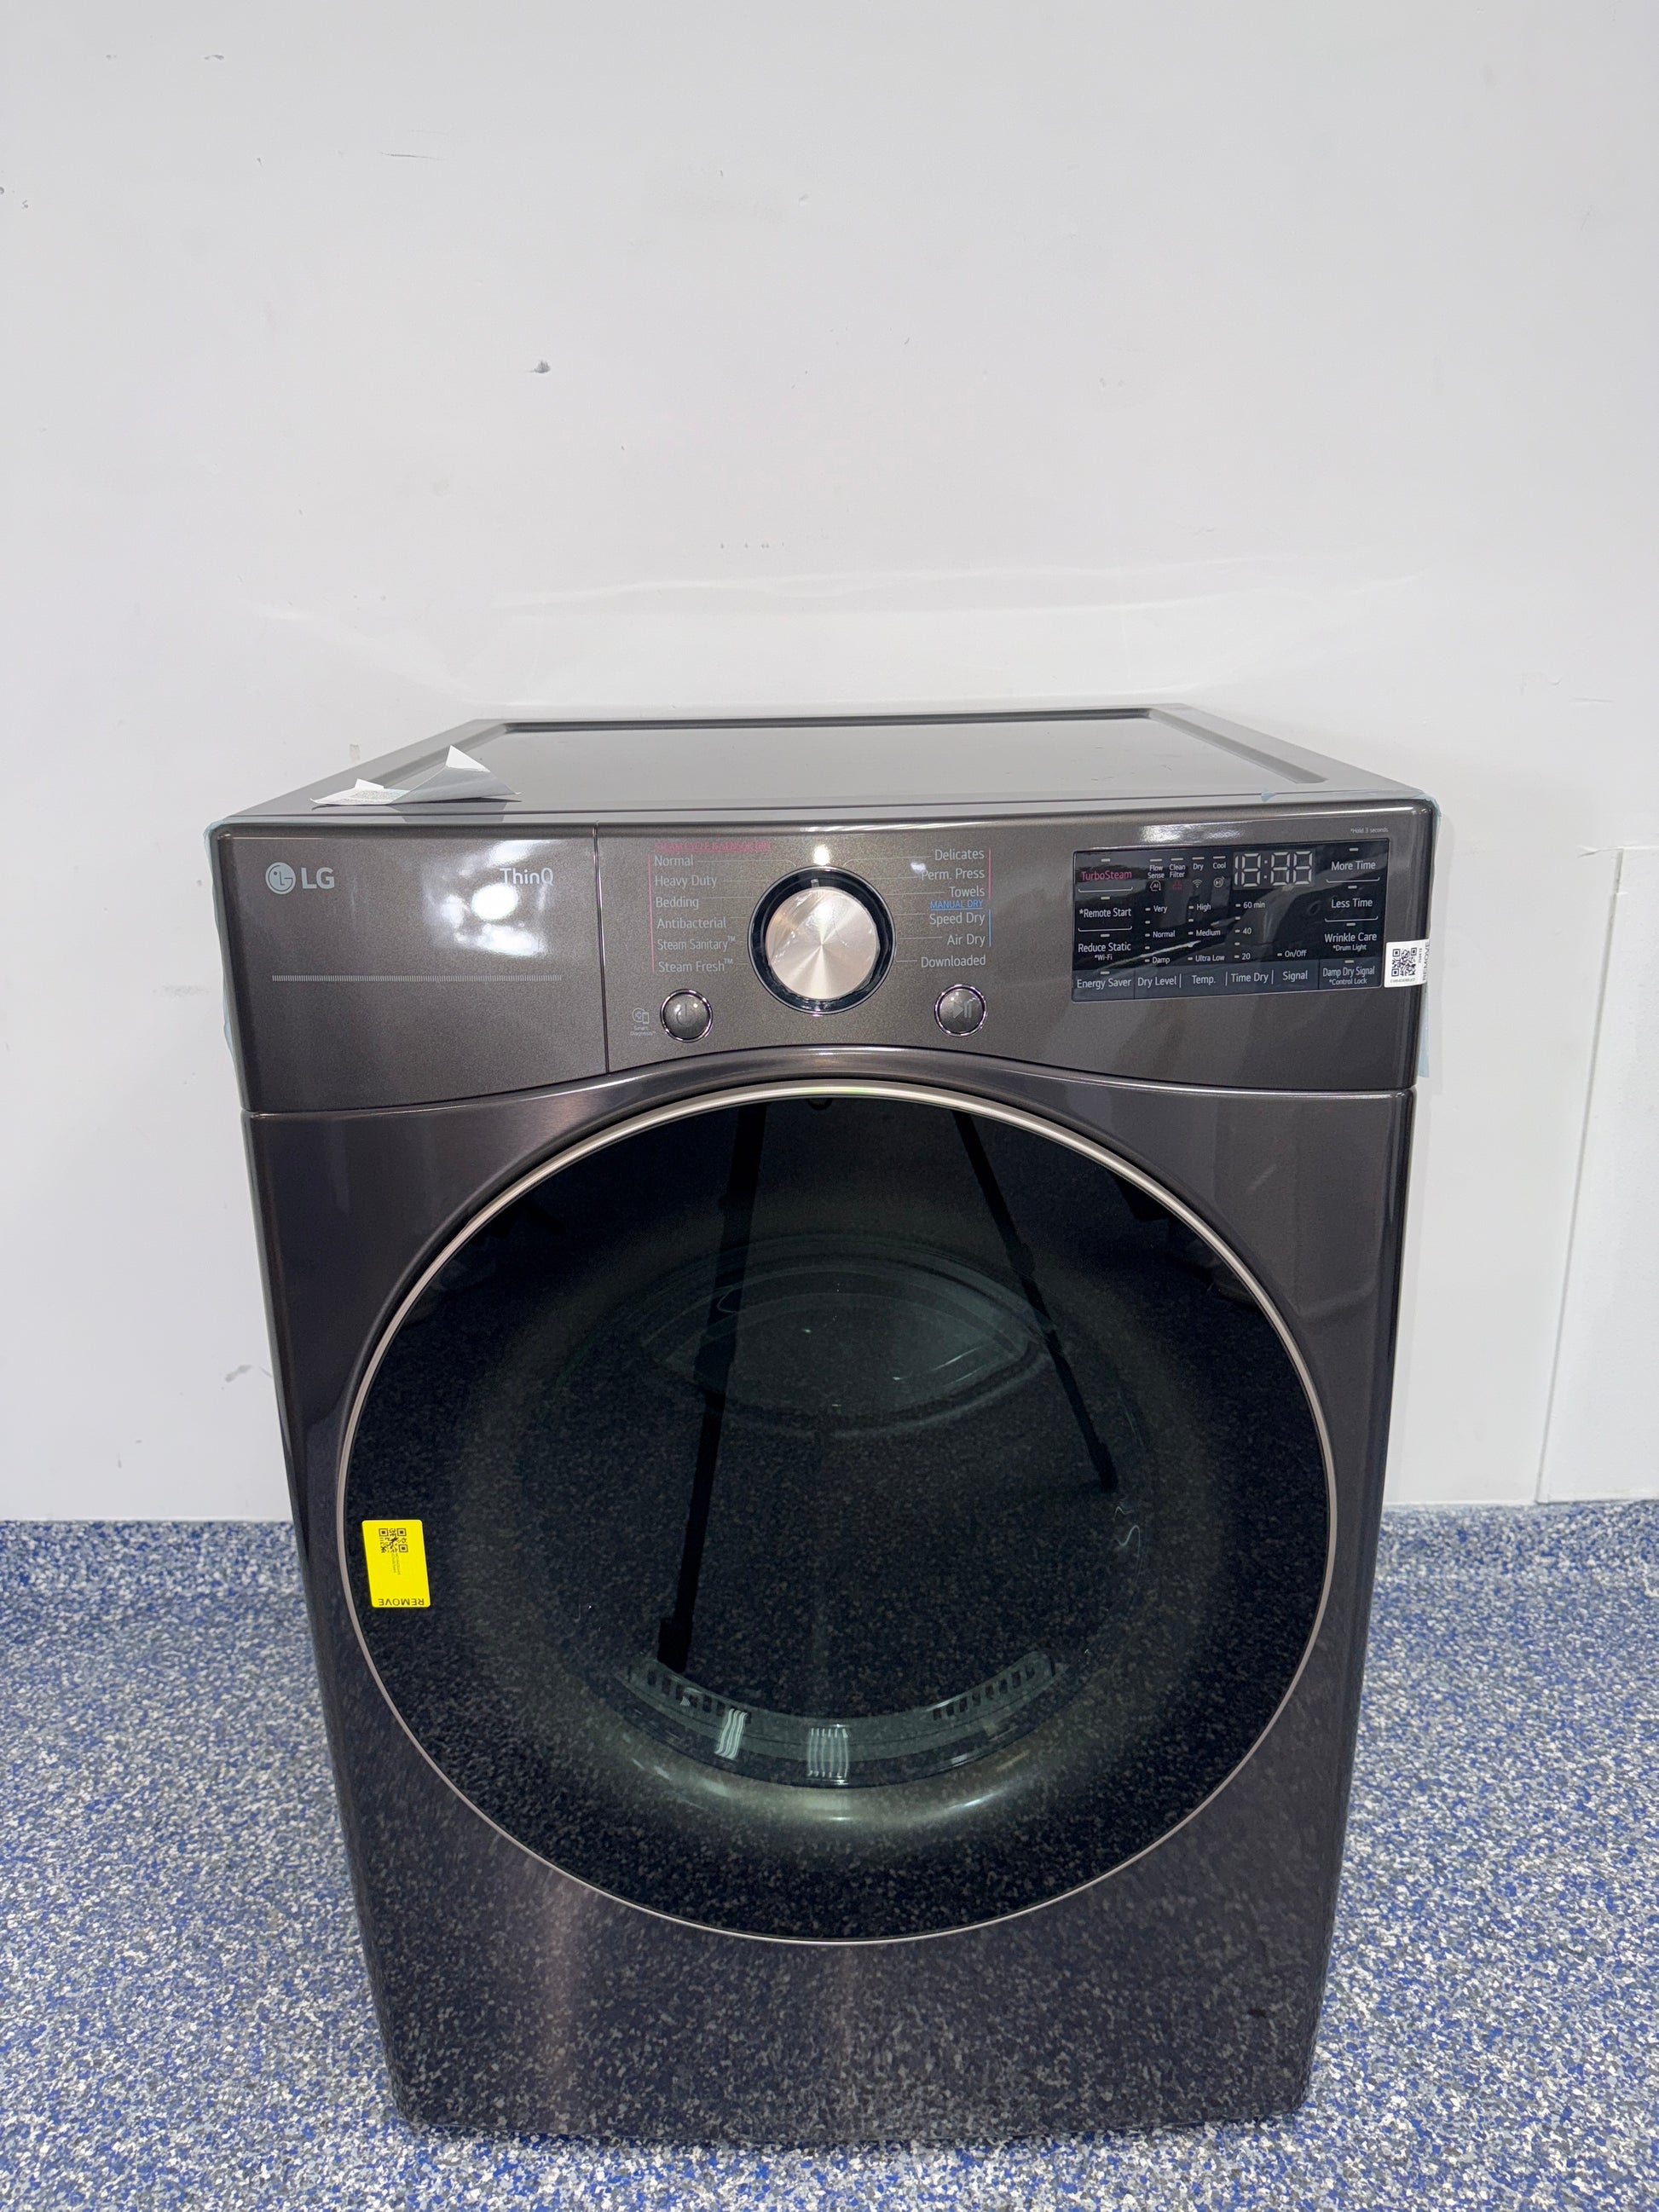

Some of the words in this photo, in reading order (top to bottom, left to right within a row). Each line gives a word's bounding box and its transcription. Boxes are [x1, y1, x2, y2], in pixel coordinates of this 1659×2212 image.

[654, 854, 693, 866] Normal
[935, 849, 985, 861] Delicates
[1194, 863, 1204, 871] Dry
[1331, 861, 1353, 870] More
[1356, 860, 1376, 869] Time
[301, 867, 335, 889] LG
[500, 868, 553, 887] ThinQ
[922, 869, 952, 881] Perm.
[956, 869, 985, 880] Press
[1081, 870, 1132, 881] TurboSteam
[655, 875, 687, 888] Heavy
[691, 875, 717, 887] Duty
[950, 886, 985, 898] Towels
[656, 897, 699, 910] Bedding
[930, 900, 965, 909] MANUAL
[968, 899, 983, 908] DRY
[1153, 904, 1168, 913] Very
[1197, 904, 1211, 913] High
[1331, 899, 1350, 909] Less
[1353, 898, 1373, 907] Time
[1113, 907, 1131, 917] Start
[657, 917, 726, 929] Antibacterial
[929, 913, 962, 927] Speed
[967, 912, 986, 926] Dry
[657, 939, 687, 950] Steam
[947, 935, 962, 946] Air
[967, 934, 986, 948] Dry
[1324, 933, 1356, 944] Wrinkle
[1358, 933, 1377, 942] Care
[1078, 943, 1106, 953] Reduce
[1108, 941, 1131, 951] Static
[1353, 944, 1367, 952] Light
[1285, 950, 1307, 958] On/Off
[922, 954, 986, 968] Downloaded
[1153, 956, 1171, 965] Damp
[659, 962, 691, 973] Steam
[1323, 967, 1341, 978] Damp
[1343, 967, 1356, 978] Dry
[1356, 966, 1375, 977] Signal
[1137, 977, 1153, 988] Dry
[1155, 975, 1176, 985] Level
[1192, 975, 1216, 985] Temp.
[1231, 973, 1251, 983] Time
[1254, 972, 1269, 984] Dry
[1282, 971, 1308, 982] Signal
[1077, 979, 1106, 990] Energy
[1108, 978, 1131, 987] Saver
